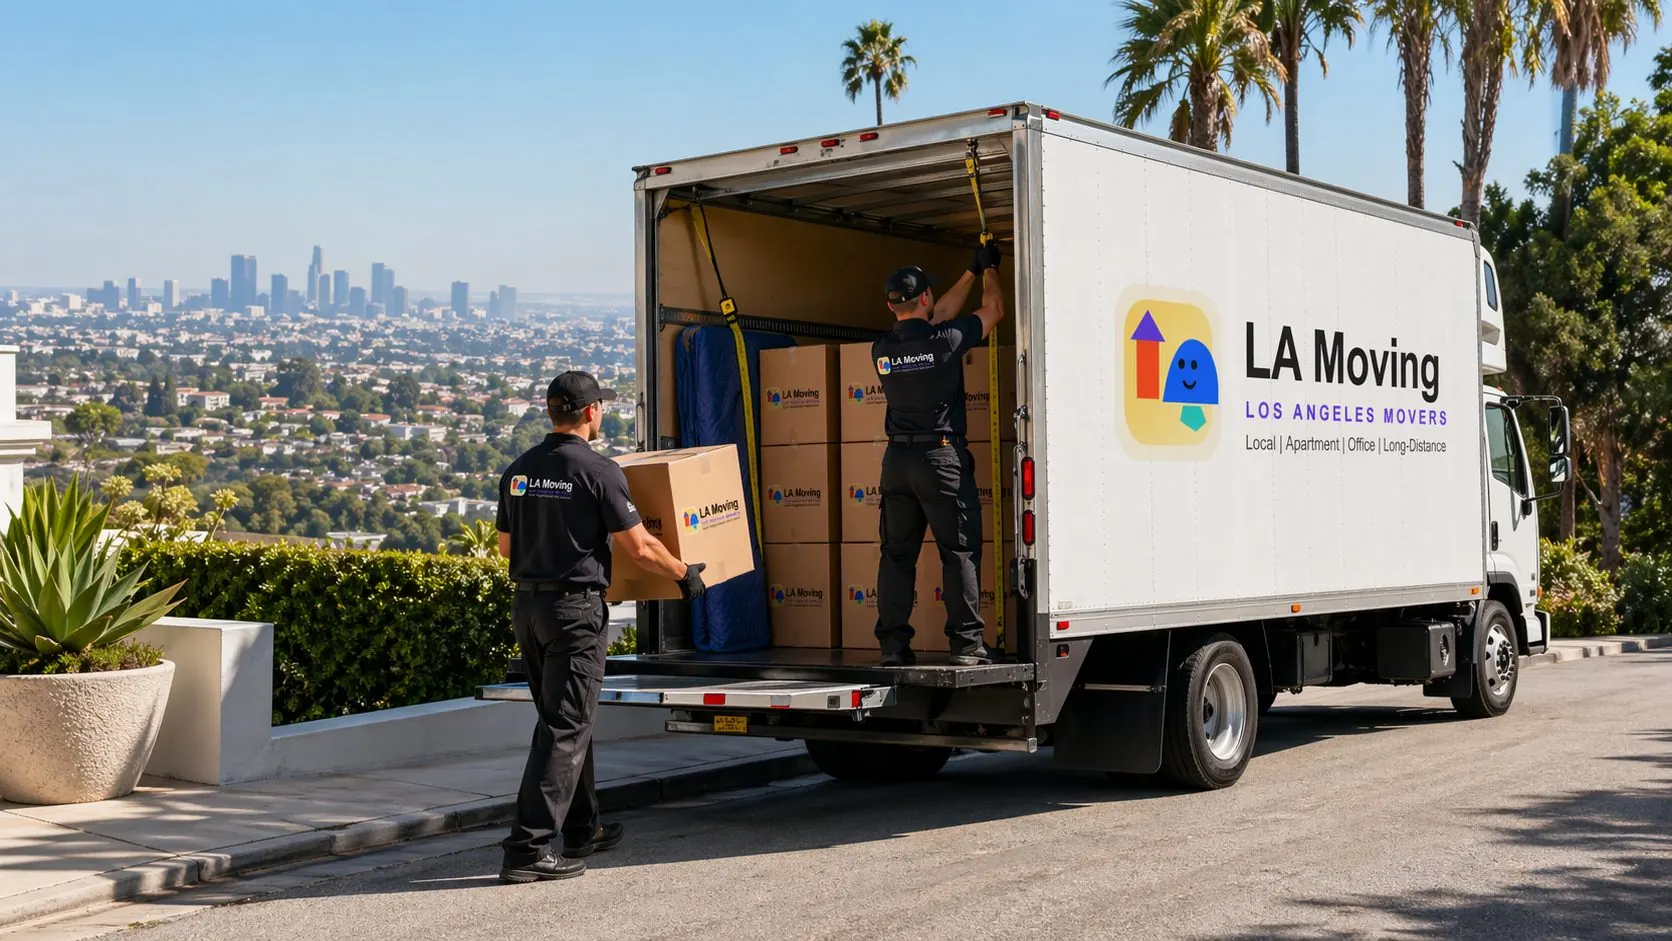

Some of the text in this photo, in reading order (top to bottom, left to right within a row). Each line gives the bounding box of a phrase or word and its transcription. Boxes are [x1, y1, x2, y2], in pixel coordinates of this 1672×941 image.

[891, 357, 903, 366] LA
[1246, 321, 1439, 403] LA Moving
[782, 388, 819, 399] LA Moving
[1246, 401, 1447, 426] LOS ANGELES MOVERS
[1246, 434, 1276, 450] Local
[1285, 435, 1340, 455] Apartment
[1347, 436, 1376, 452] Office
[1383, 437, 1447, 456] Long-Distance
[529, 478, 573, 493] LA Moving
[783, 487, 821, 499] LA Moving
[699, 499, 739, 519] LA Moving
